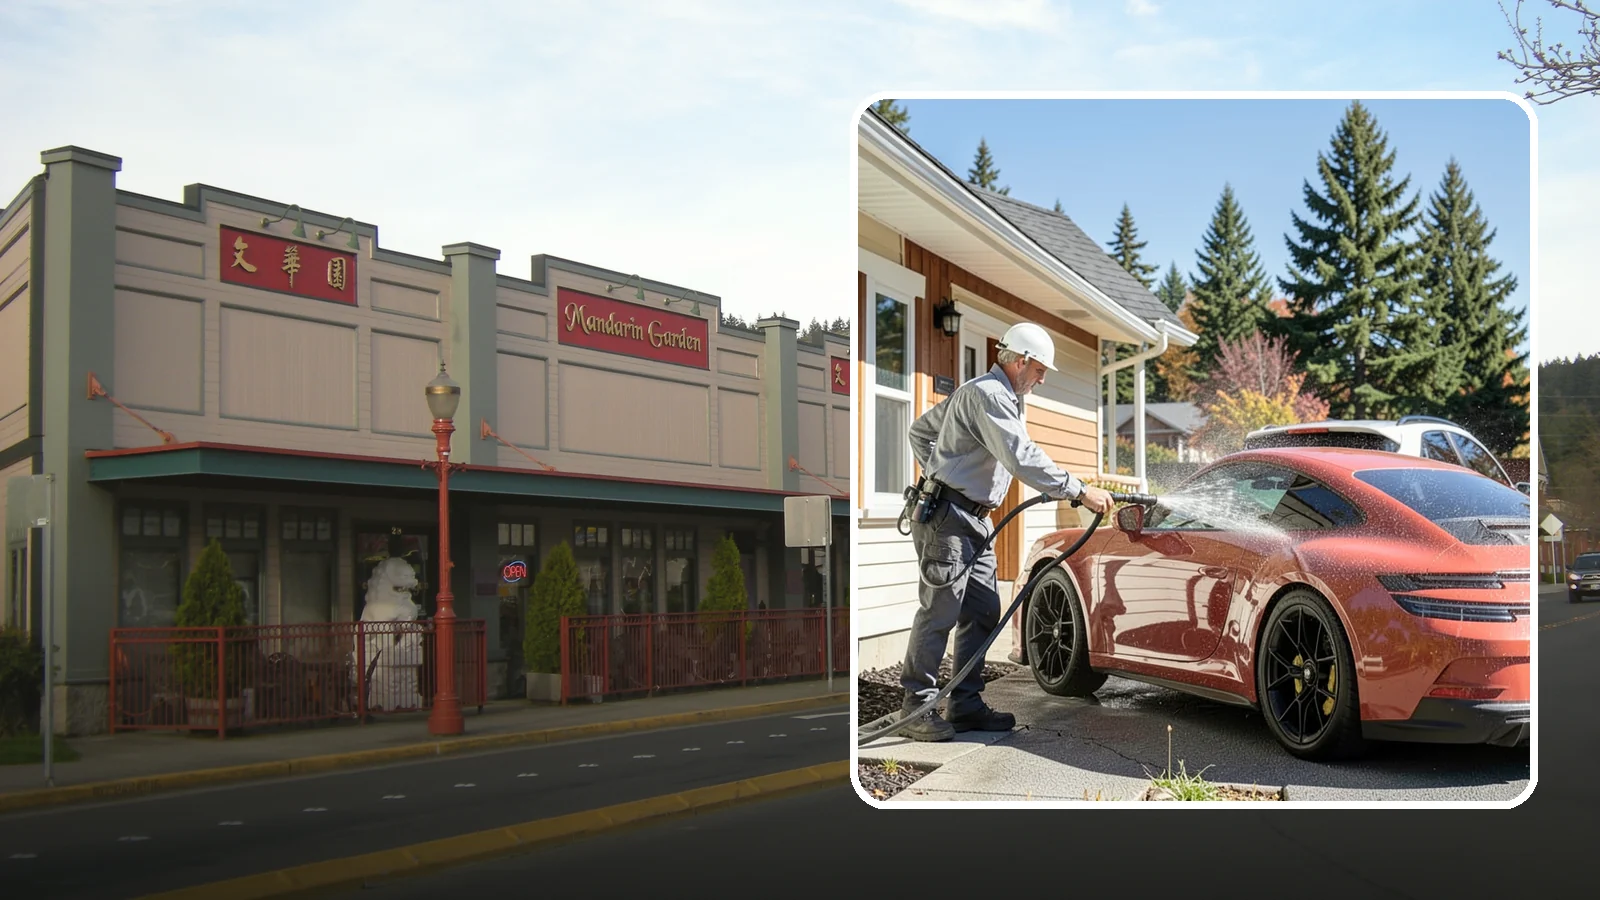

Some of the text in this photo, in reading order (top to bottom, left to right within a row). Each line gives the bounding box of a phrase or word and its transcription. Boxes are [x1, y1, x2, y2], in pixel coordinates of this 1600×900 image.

[564, 302, 702, 352] Mandarin Garden
[503, 565, 527, 578] OPEN
